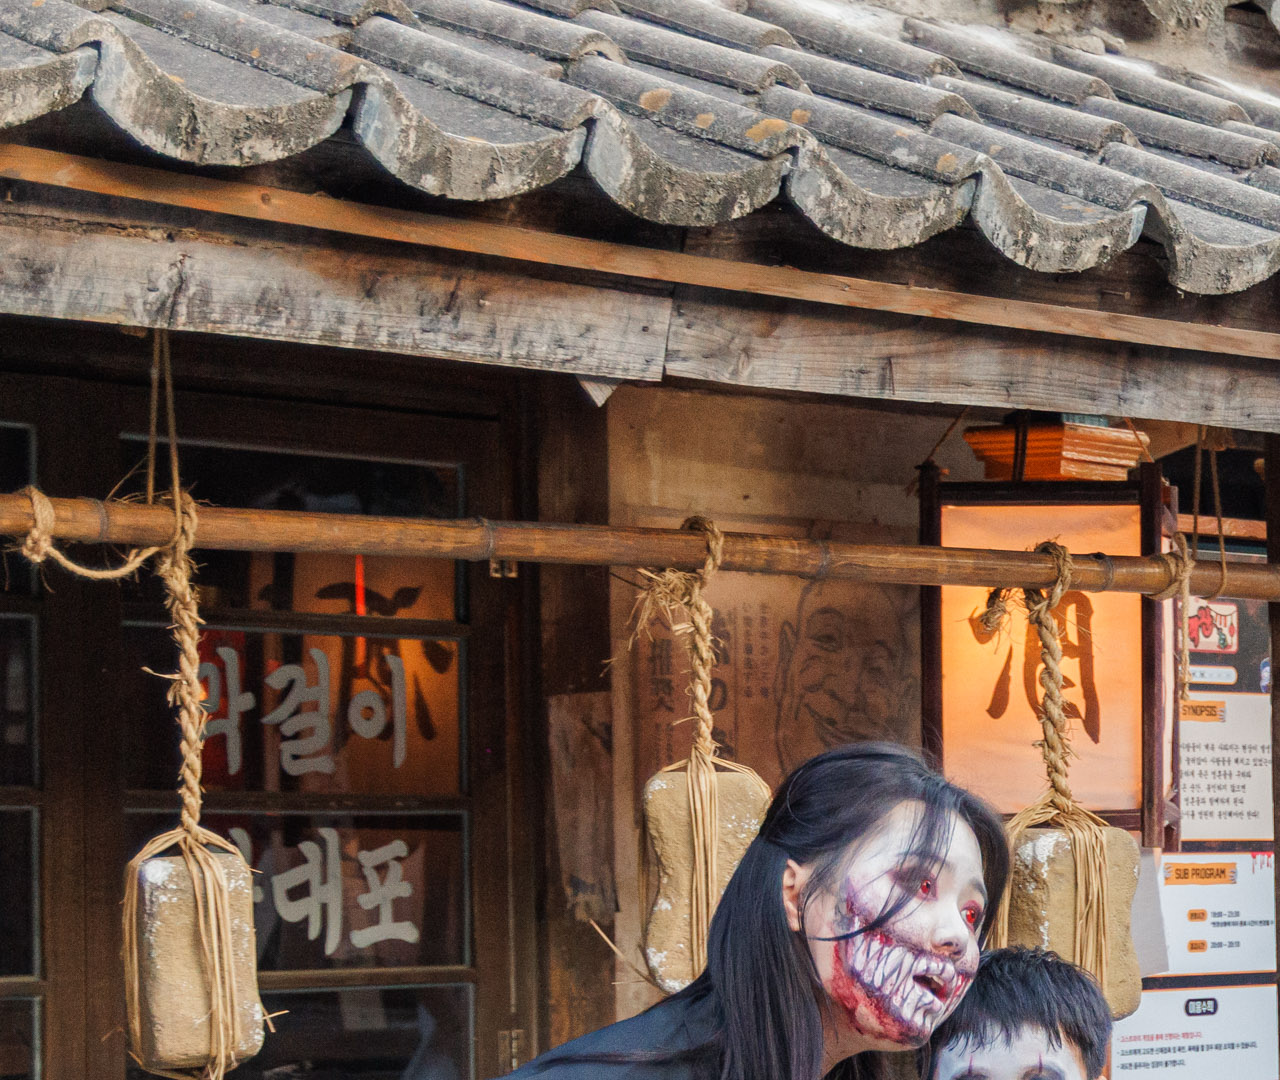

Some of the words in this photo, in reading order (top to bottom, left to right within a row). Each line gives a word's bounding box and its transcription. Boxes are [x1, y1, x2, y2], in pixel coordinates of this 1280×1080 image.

[1181, 704, 1218, 717] SYNOPSIS
[1175, 868, 1189, 880] SUB
[1191, 867, 1227, 879] PROGRAM
